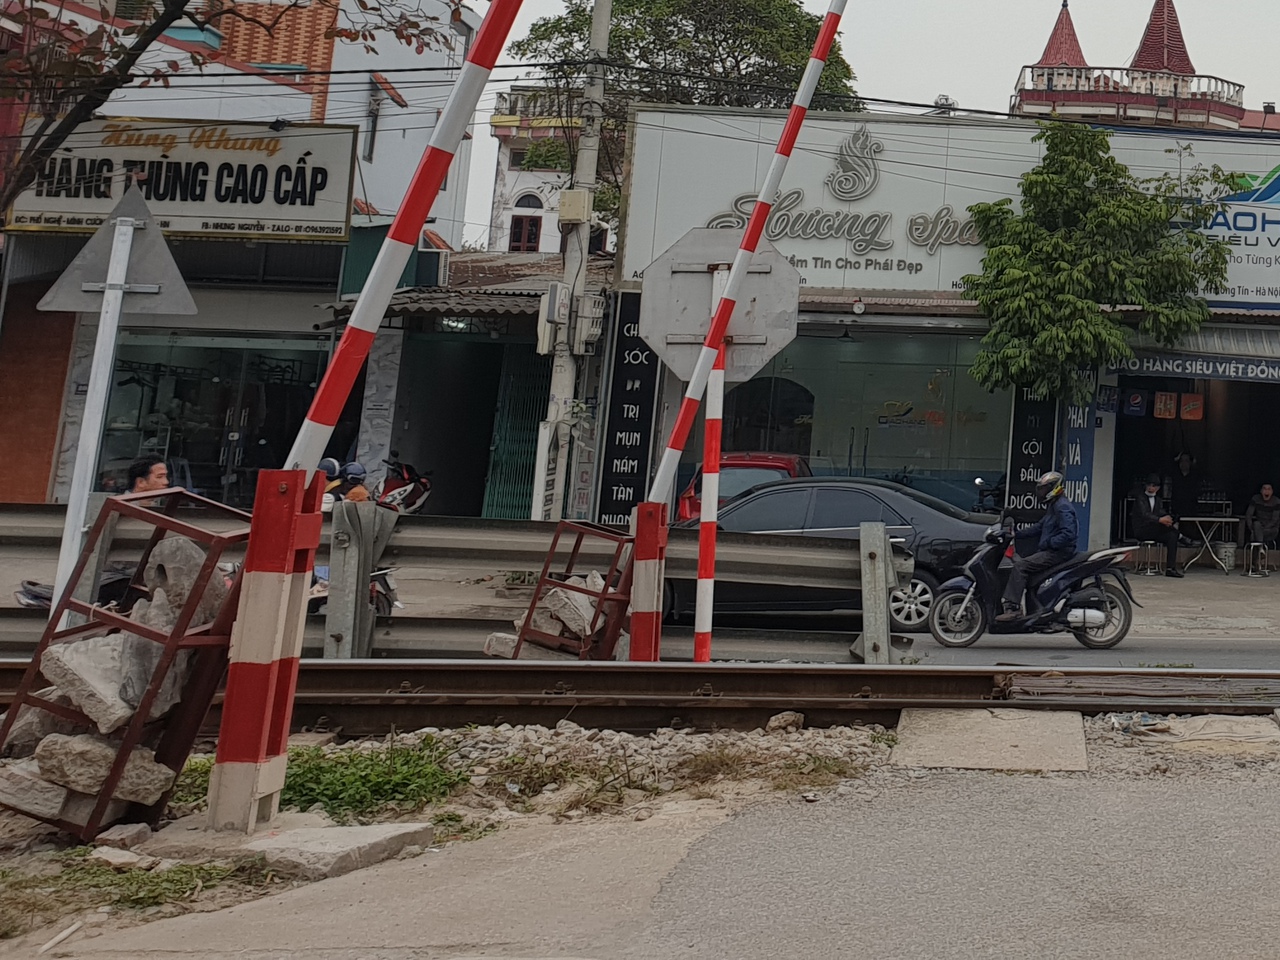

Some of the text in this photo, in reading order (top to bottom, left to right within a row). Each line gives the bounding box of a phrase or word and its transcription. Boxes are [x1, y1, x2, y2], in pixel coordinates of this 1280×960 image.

[35, 147, 329, 207] HÀNG THÙNG CAO CẤP
[272, 224, 290, 233] ZALO
[835, 257, 861, 271] Cho
[864, 258, 893, 272] Phái
[897, 260, 923, 275] Đẹp
[1246, 252, 1272, 268] Từng
[1237, 285, 1280, 298] Tín Hà Nội
[624, 347, 650, 364] SÓC
[1107, 356, 1140, 371] GIAO
[1143, 354, 1183, 372] HÀNG
[1185, 358, 1213, 374] SIÊU
[1216, 358, 1247, 378] VIỆT
[623, 404, 640, 421] TRỊ
[616, 431, 641, 449] MỤN
[1022, 438, 1043, 458] GỘI
[1069, 438, 1082, 466] VÀ
[613, 458, 638, 474] NÁM
[612, 483, 634, 501] TÀN
[1075, 476, 1089, 507] HỘ
